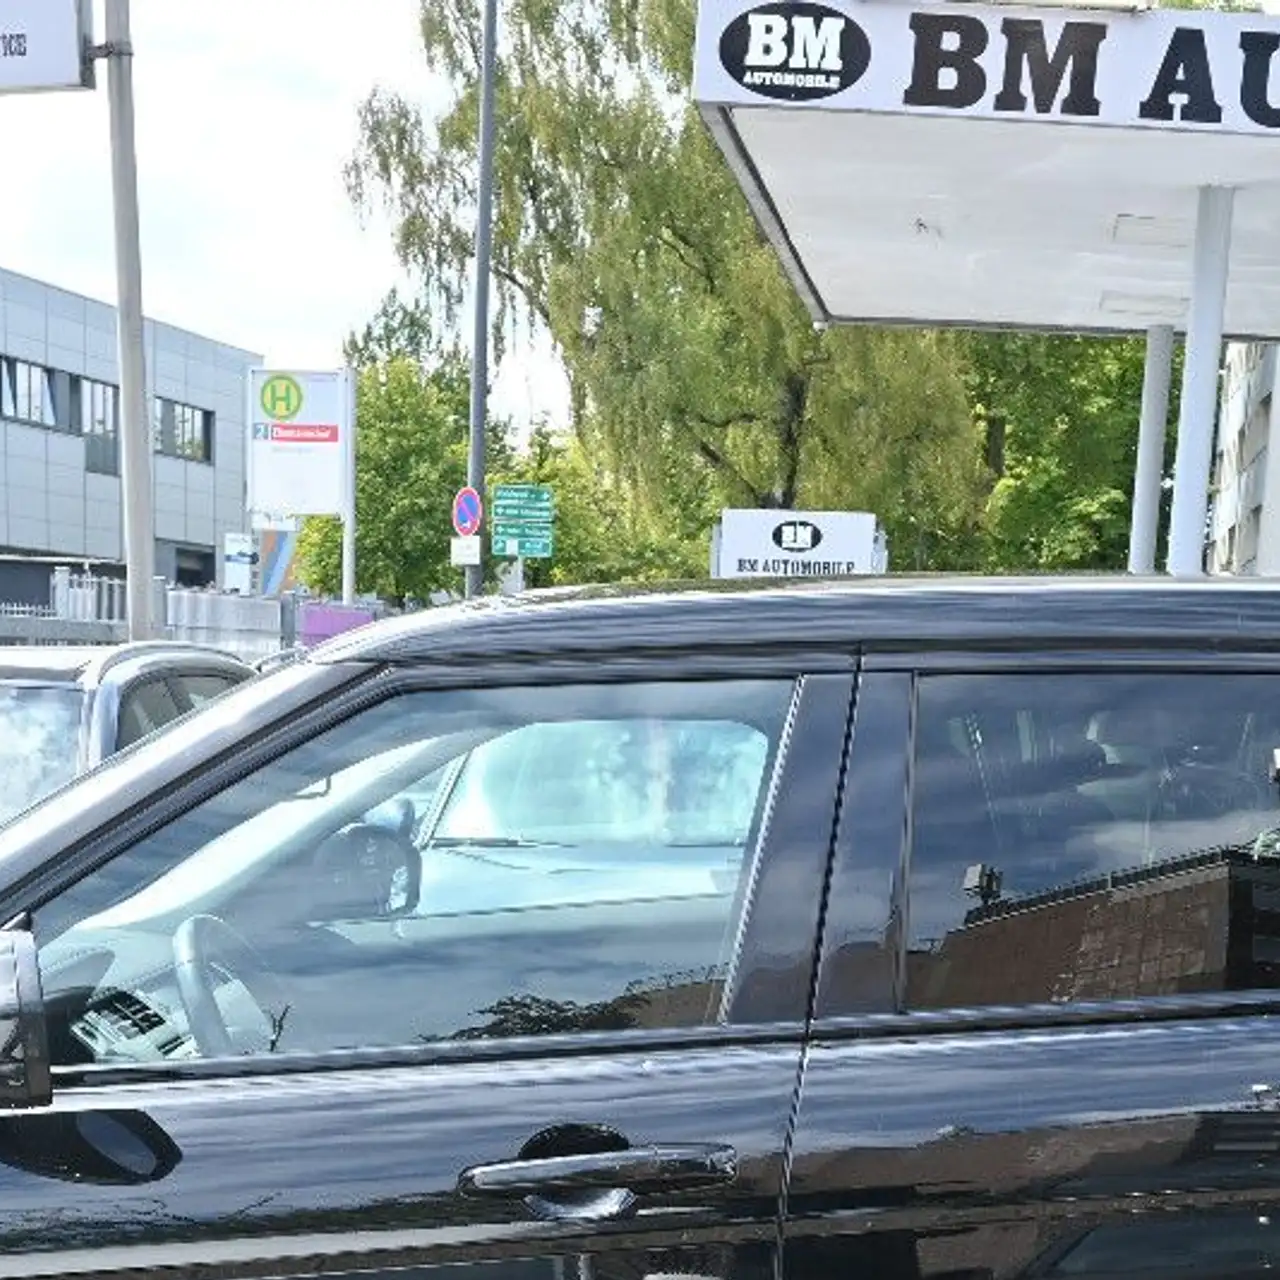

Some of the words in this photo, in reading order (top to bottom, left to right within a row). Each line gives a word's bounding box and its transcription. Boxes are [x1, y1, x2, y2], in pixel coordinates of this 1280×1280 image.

[744, 13, 846, 71] BM
[903, 12, 1108, 116] BM
[744, 70, 841, 88] AUTOMOBILE
